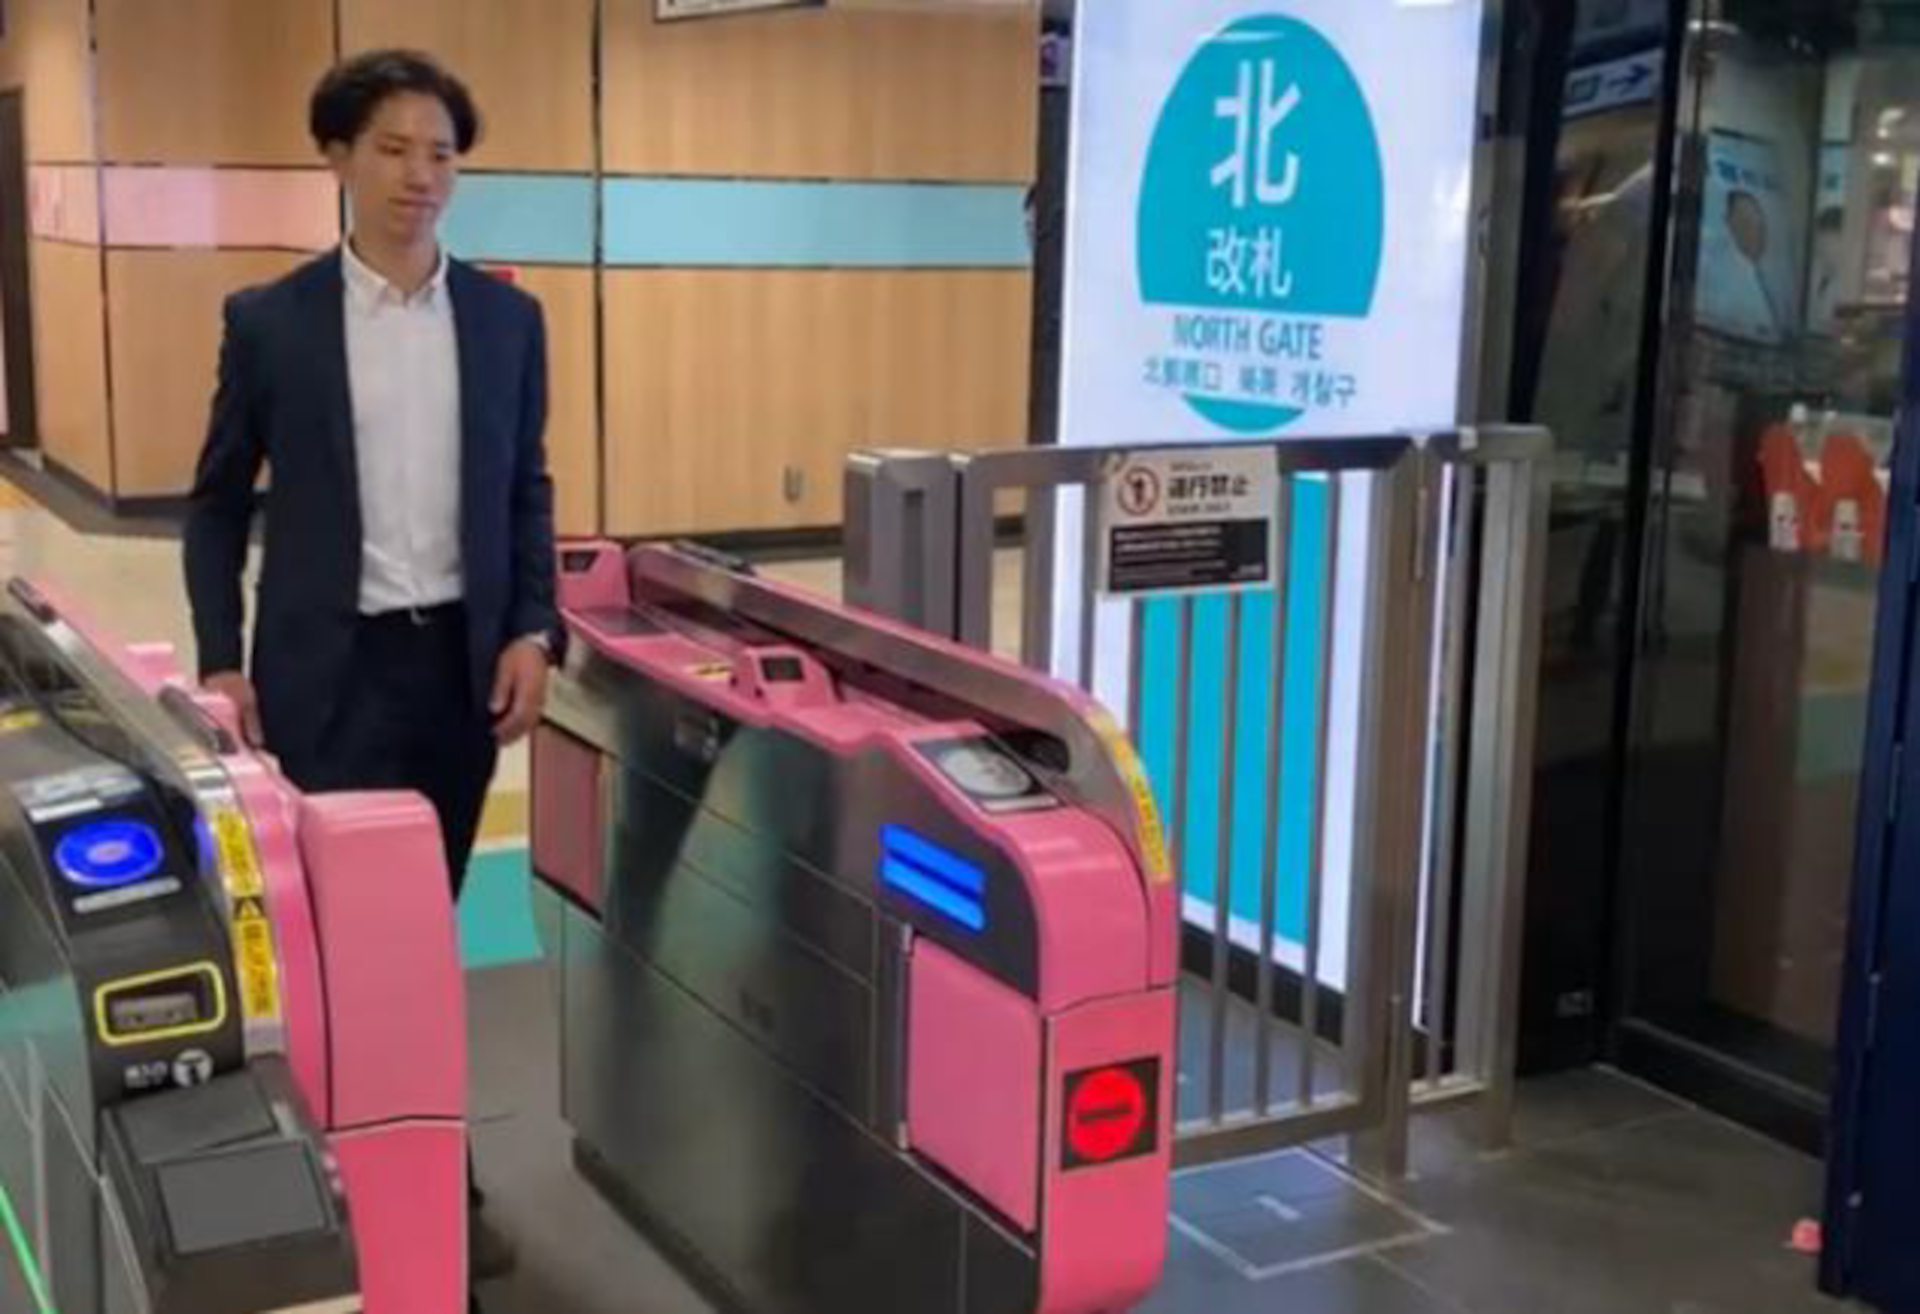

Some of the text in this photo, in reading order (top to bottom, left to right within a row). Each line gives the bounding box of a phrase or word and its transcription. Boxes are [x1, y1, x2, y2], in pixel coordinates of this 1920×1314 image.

[1210, 58, 1302, 208] 北
[1206, 225, 1293, 298] 改札
[1173, 313, 1323, 360] NORTH GATE
